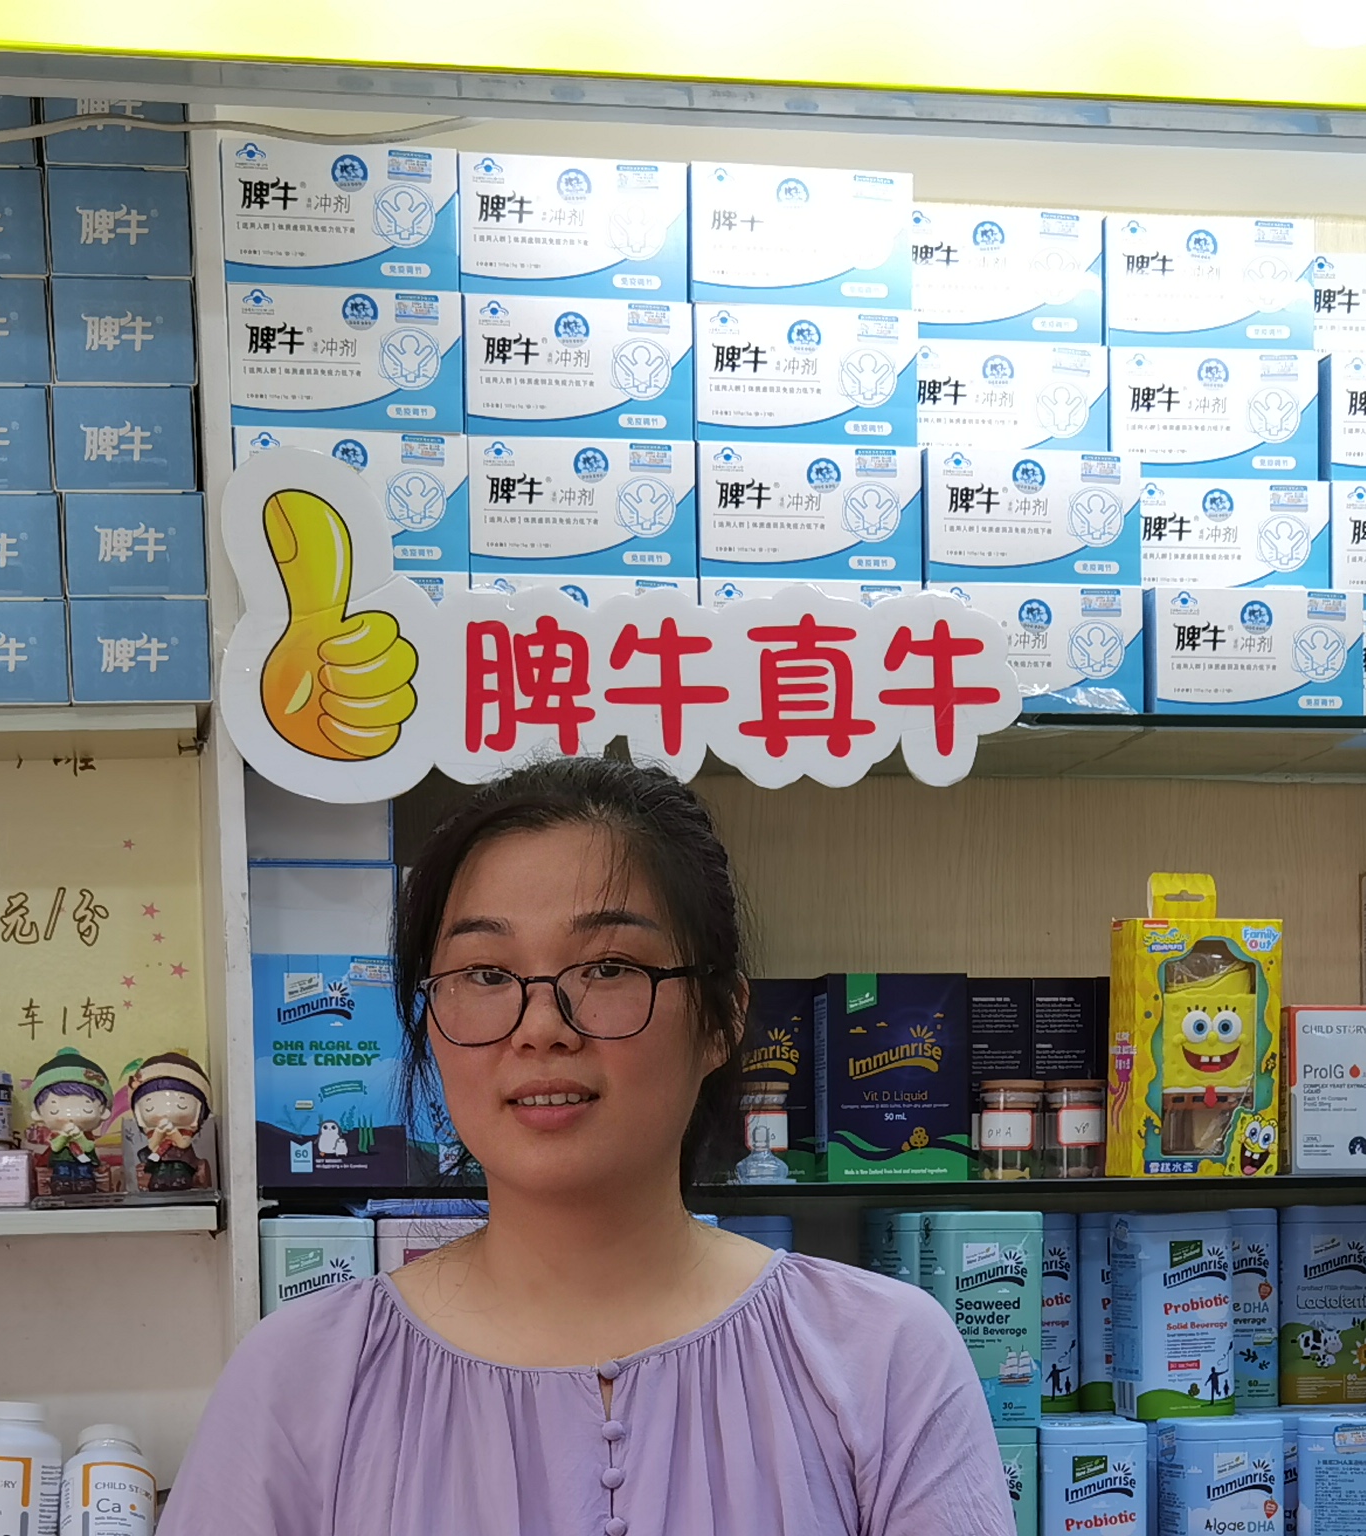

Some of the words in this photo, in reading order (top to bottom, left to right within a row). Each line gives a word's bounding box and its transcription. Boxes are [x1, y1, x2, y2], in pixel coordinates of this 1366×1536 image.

[238, 177, 298, 210] 脾牛
[314, 194, 351, 214] 冲剂
[76, 205, 150, 245] 脾牛
[81, 310, 154, 351] 脾牛
[245, 322, 305, 355] 脾牛
[320, 338, 357, 358] 冲剂
[482, 333, 539, 365] 脾牛
[712, 342, 768, 373] 脾牛
[554, 349, 590, 368] 冲剂
[783, 357, 817, 376] 冲剂
[80, 420, 152, 461] 脾牛
[486, 474, 544, 504] 脾牛
[559, 488, 595, 507] 冲剂
[786, 492, 821, 511] 冲剂
[1014, 498, 1048, 516] 冲剂
[1206, 526, 1238, 544] 冲剂
[464, 612, 1001, 758] 脾牛真牛
[1242, 928, 1279, 941] Family
[1248, 939, 1272, 950] Out
[277, 996, 356, 1026] Immunrise
[1302, 1025, 1333, 1034] CHILD
[272, 1040, 306, 1052] DHA
[357, 1040, 381, 1051] OIL
[272, 1054, 308, 1067] GEL
[314, 1053, 381, 1067] CANDY
[849, 1042, 943, 1077] Immunrise
[863, 1091, 878, 1101] Vit
[882, 1091, 890, 1100] D
[894, 1090, 928, 1101] Liquid
[895, 1113, 907, 1121] mL
[294, 1149, 309, 1160] 60
[955, 1263, 1028, 1291] Immunrise
[1163, 1261, 1229, 1288] Immunrise
[955, 1297, 1020, 1311] Seaweed
[1163, 1295, 1229, 1315] Probiotic
[1242, 1303, 1270, 1314] DHA
[956, 1311, 1011, 1325] Powder
[1166, 1322, 1188, 1331] Solid
[1189, 1321, 1228, 1330] Beverage
[1065, 1477, 1136, 1502] Immunrise
[1206, 1472, 1275, 1500] Immunrise
[96, 1498, 121, 1513] Ca
[1065, 1511, 1136, 1532] Probiotic
[1204, 1518, 1246, 1534] Algae
[1247, 1520, 1275, 1533] DHA
